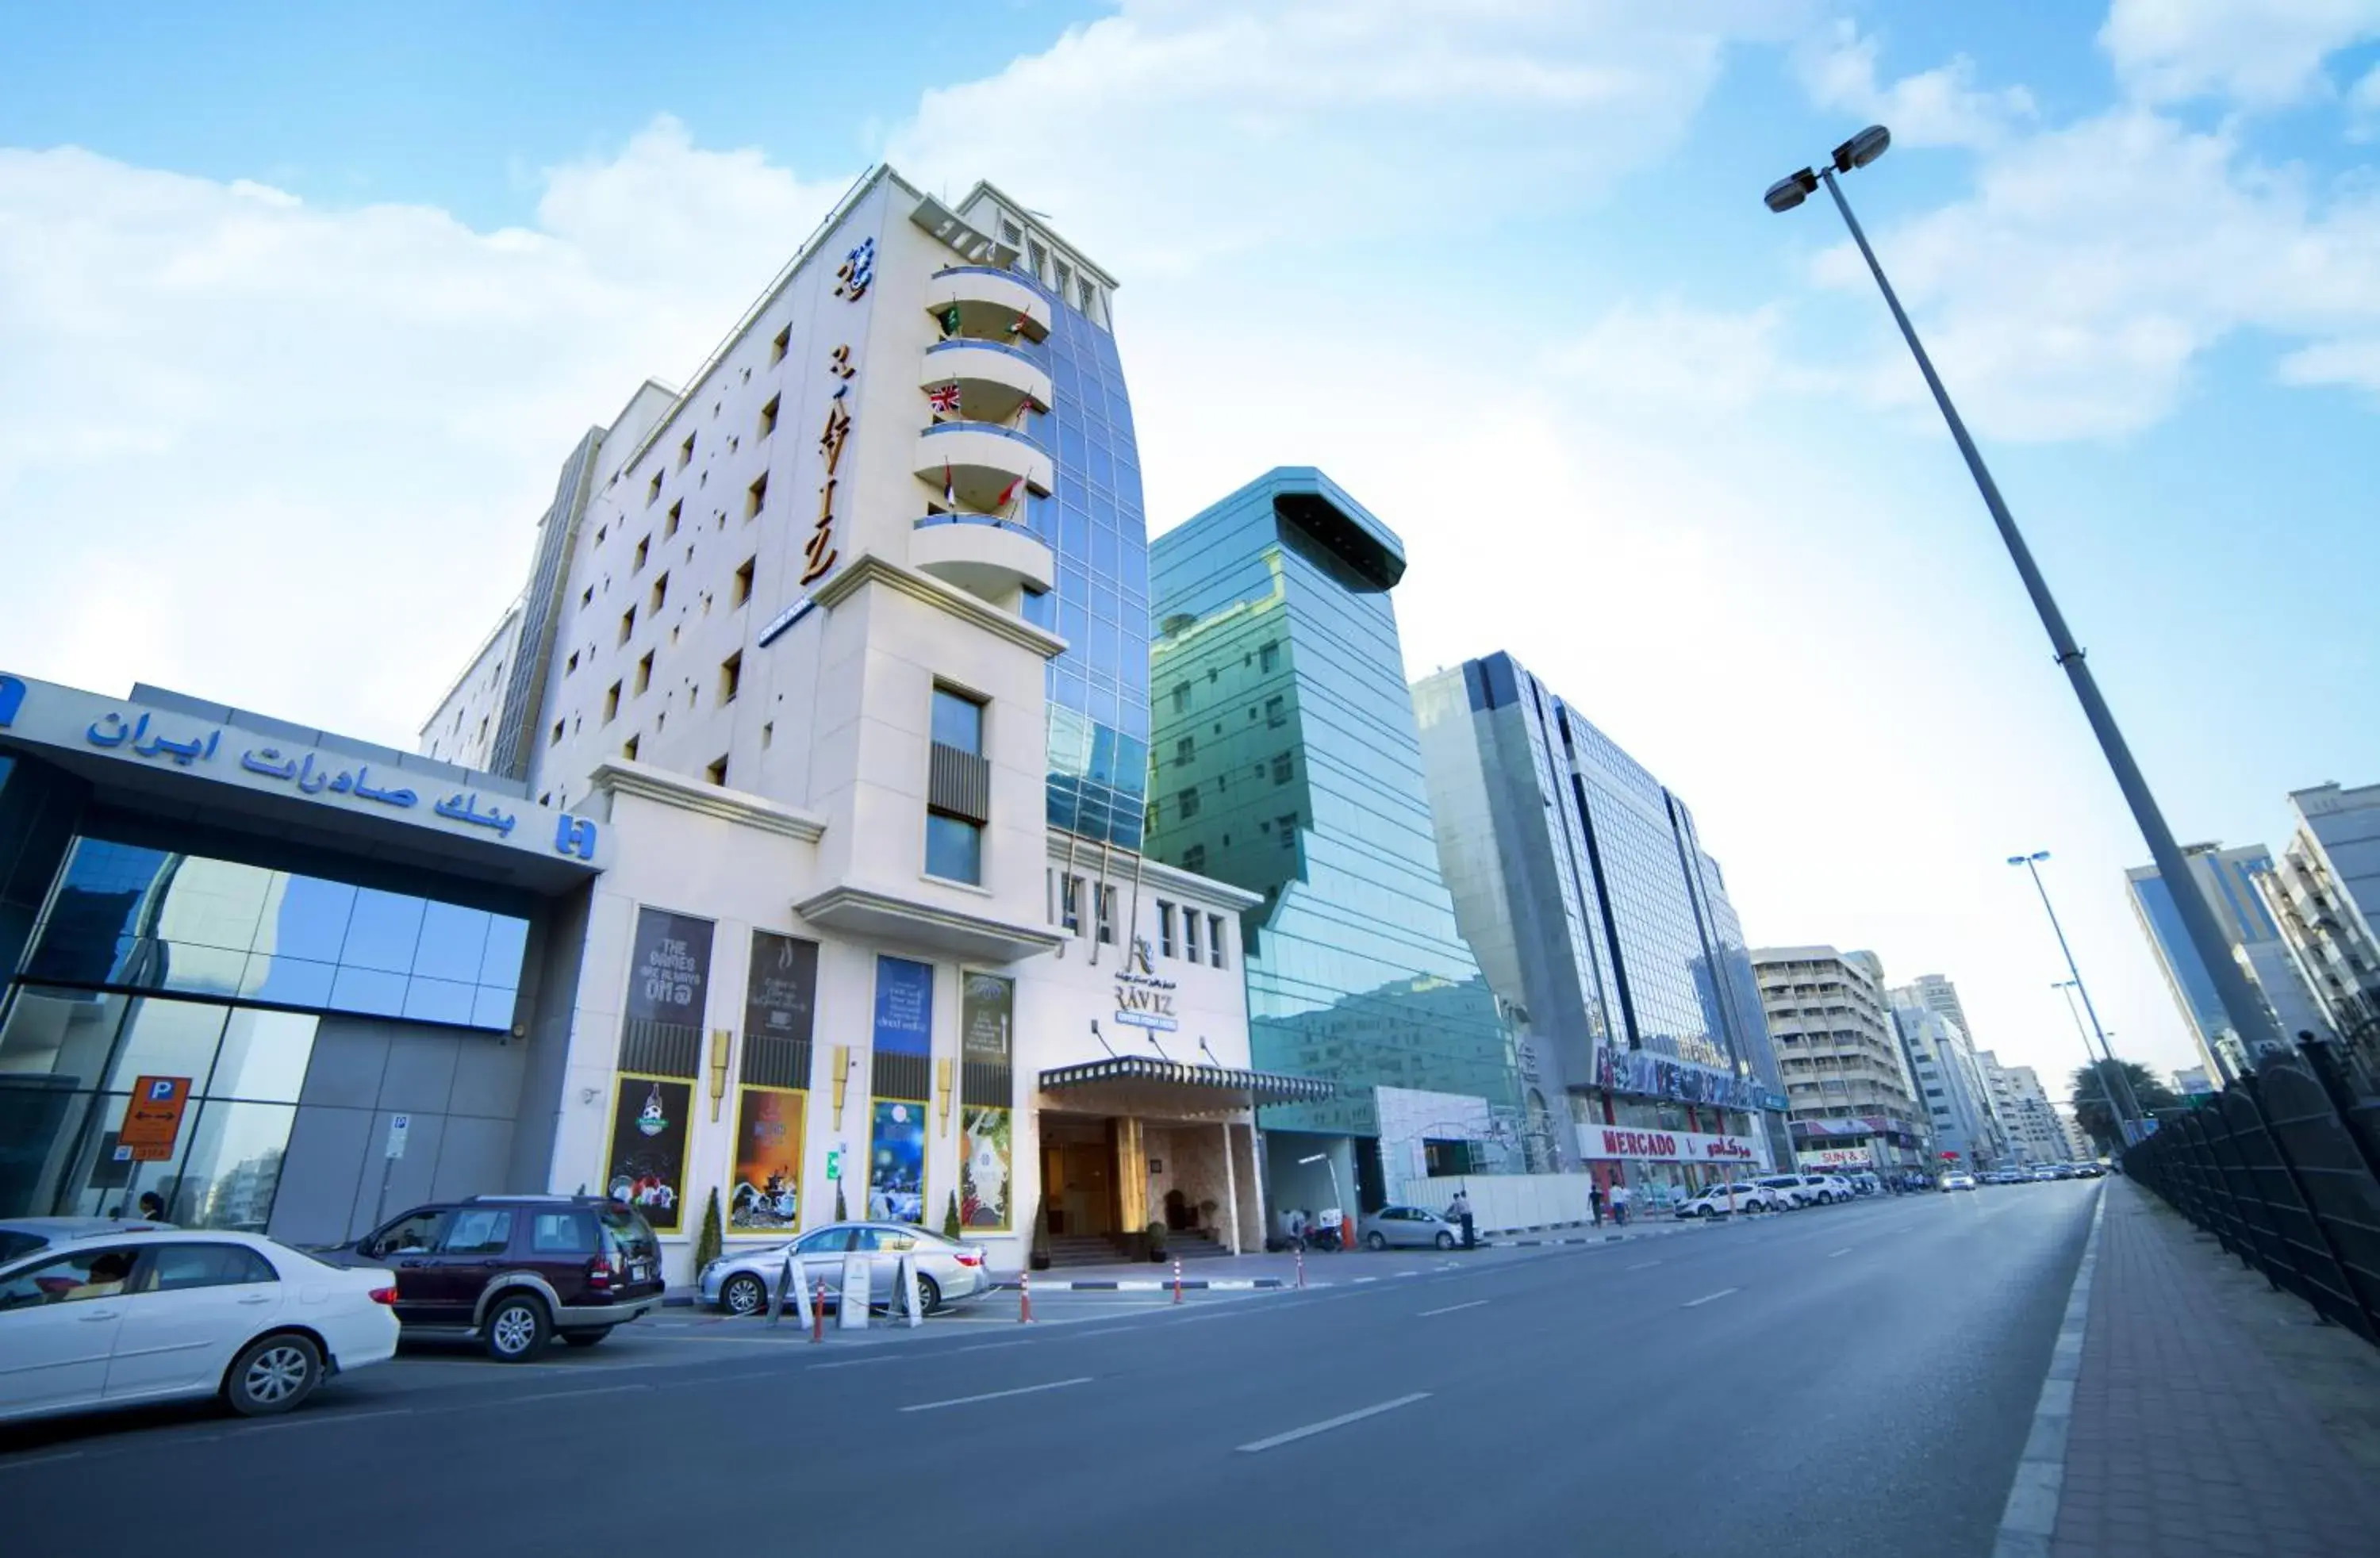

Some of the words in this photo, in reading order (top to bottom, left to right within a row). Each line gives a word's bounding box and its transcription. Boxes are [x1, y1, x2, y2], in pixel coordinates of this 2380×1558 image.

[86, 712, 221, 766] ايران
[240, 747, 418, 808] صادرات
[434, 793, 516, 838] بنك
[663, 938, 688, 956] THE
[152, 1081, 172, 1099] P
[1602, 1130, 1676, 1156] MERCADO
[1821, 1152, 1846, 1162] SUN
